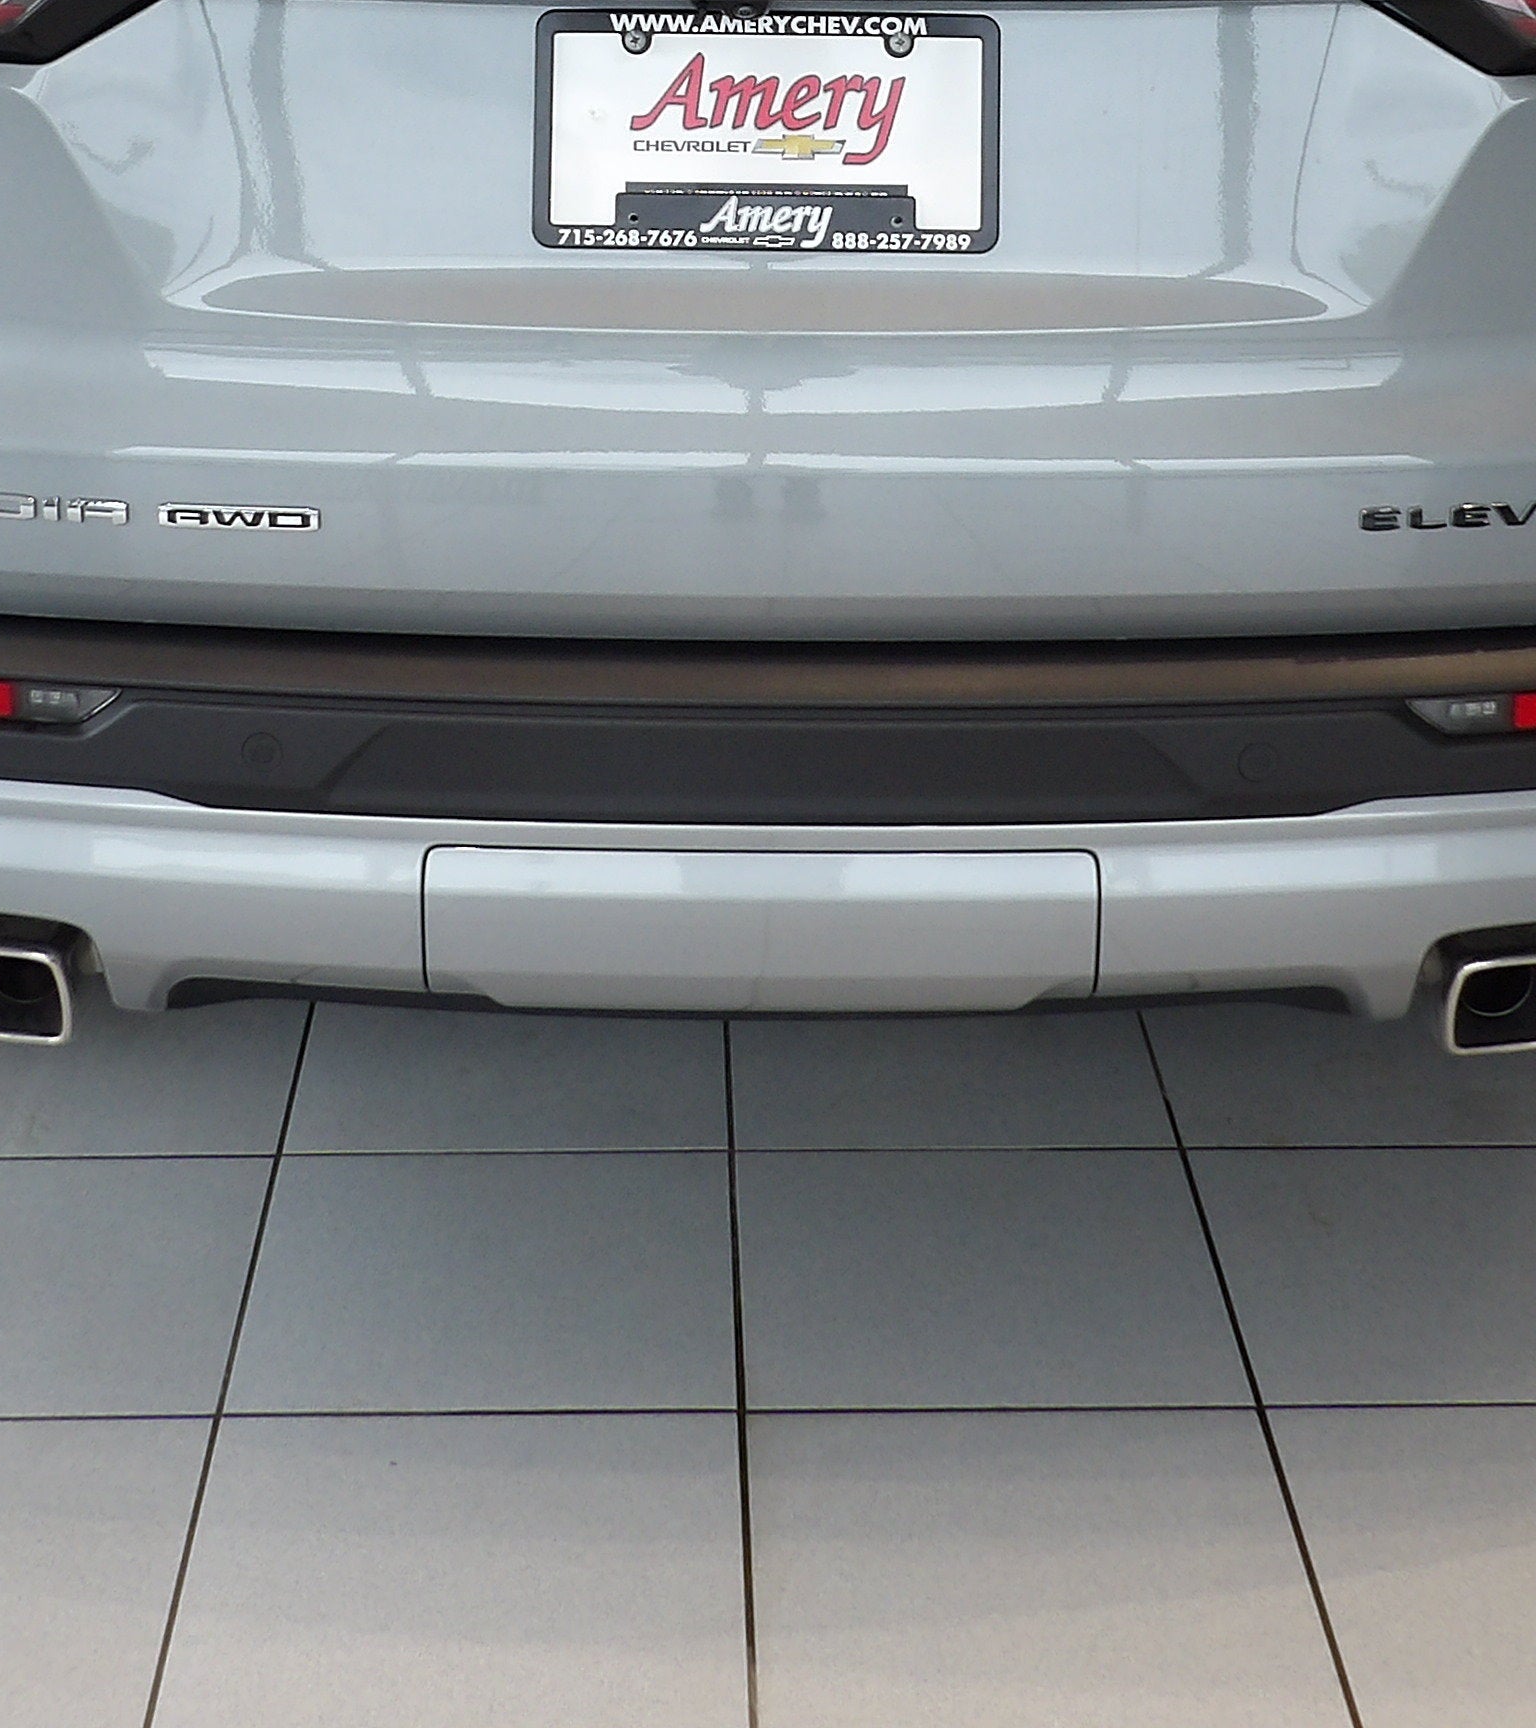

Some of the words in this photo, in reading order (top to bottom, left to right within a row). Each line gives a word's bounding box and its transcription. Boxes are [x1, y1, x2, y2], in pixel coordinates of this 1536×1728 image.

[610, 13, 928, 36] WWW.AMERYCHEV.COM
[629, 52, 906, 165] Amery
[633, 139, 752, 153] CHEVROLET
[699, 195, 834, 248] Amery
[558, 229, 697, 247] 715-268-7676
[831, 232, 971, 250] 888-257-7989
[162, 505, 317, 531] AWD
